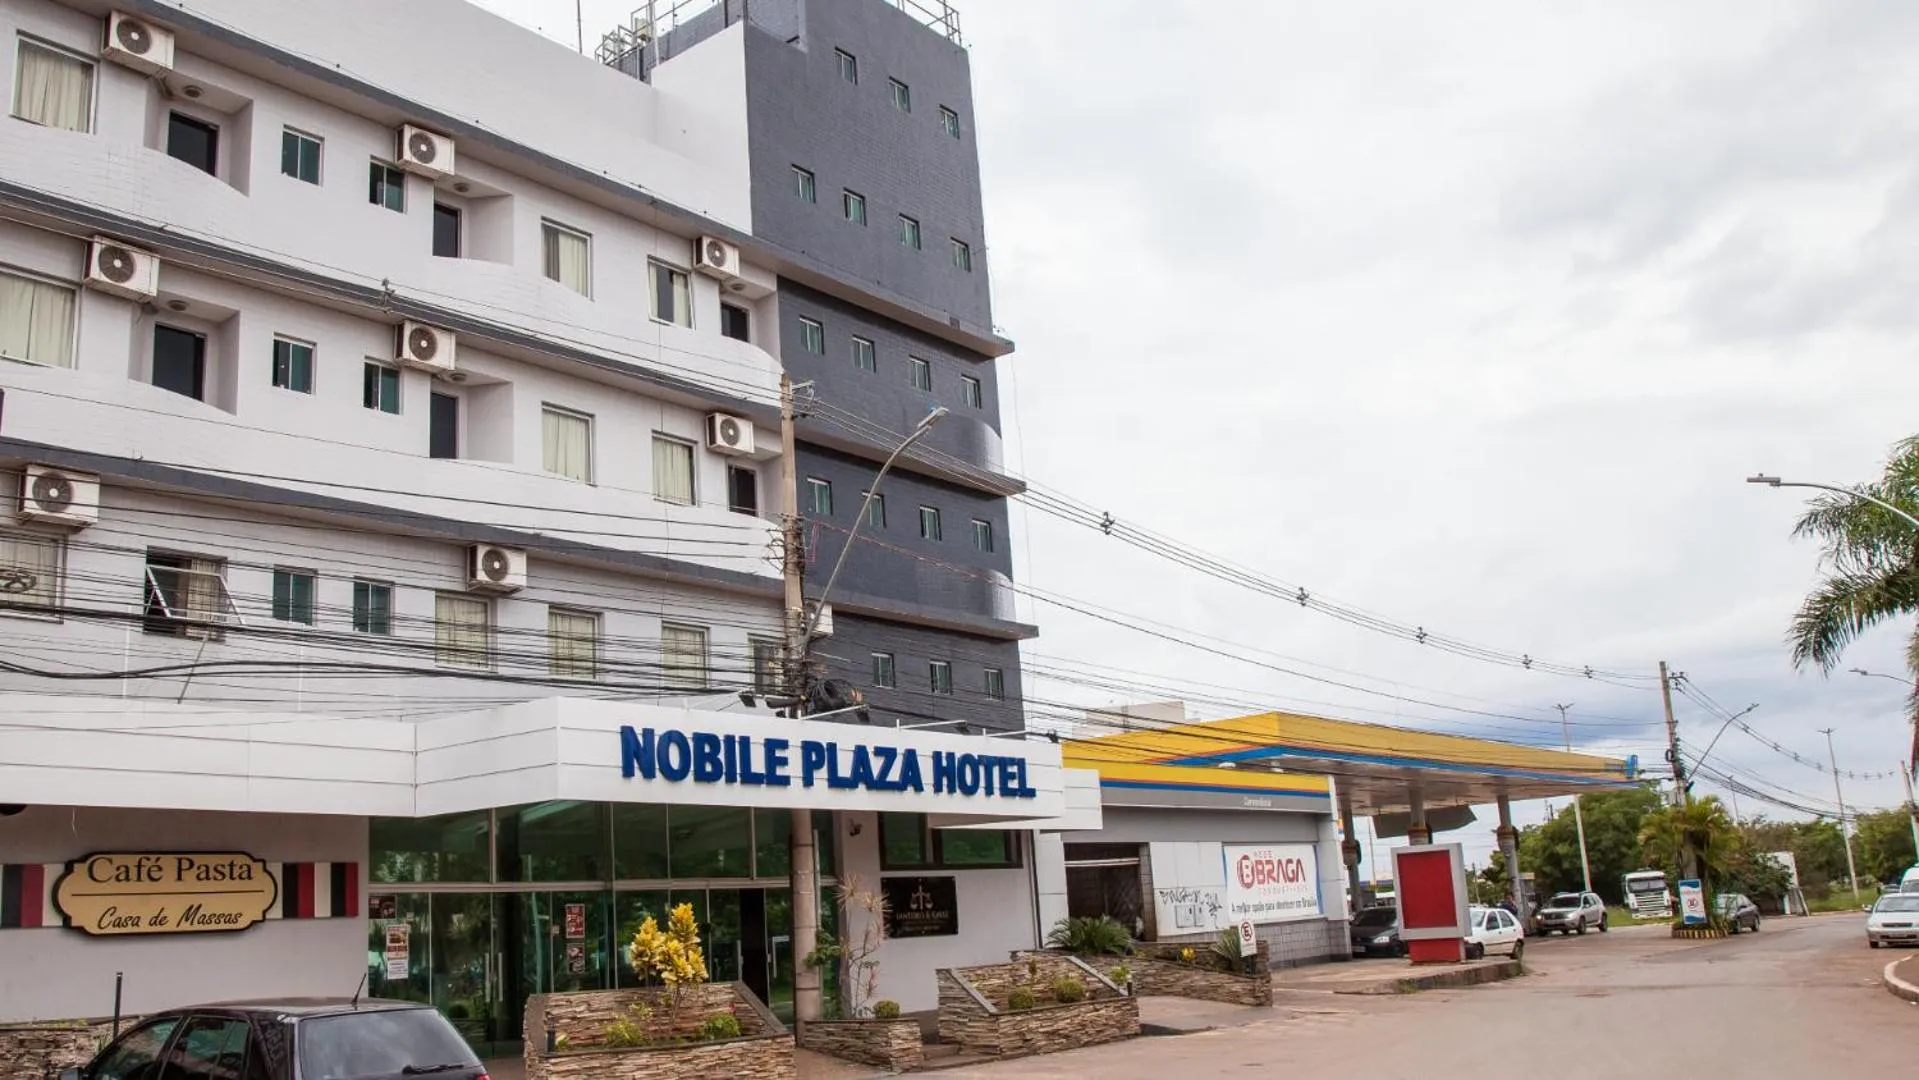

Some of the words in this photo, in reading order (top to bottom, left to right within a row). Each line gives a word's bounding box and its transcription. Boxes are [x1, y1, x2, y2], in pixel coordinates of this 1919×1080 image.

[620, 725, 791, 786] NOBILE
[801, 740, 924, 793] PLAZA
[932, 751, 1037, 798] HOTEL
[87, 857, 164, 884] Café
[175, 857, 254, 882] Pasta
[1254, 858, 1306, 885] BRAGA
[97, 906, 140, 930] Casa
[148, 907, 169, 926] de
[176, 904, 243, 928] Massas
